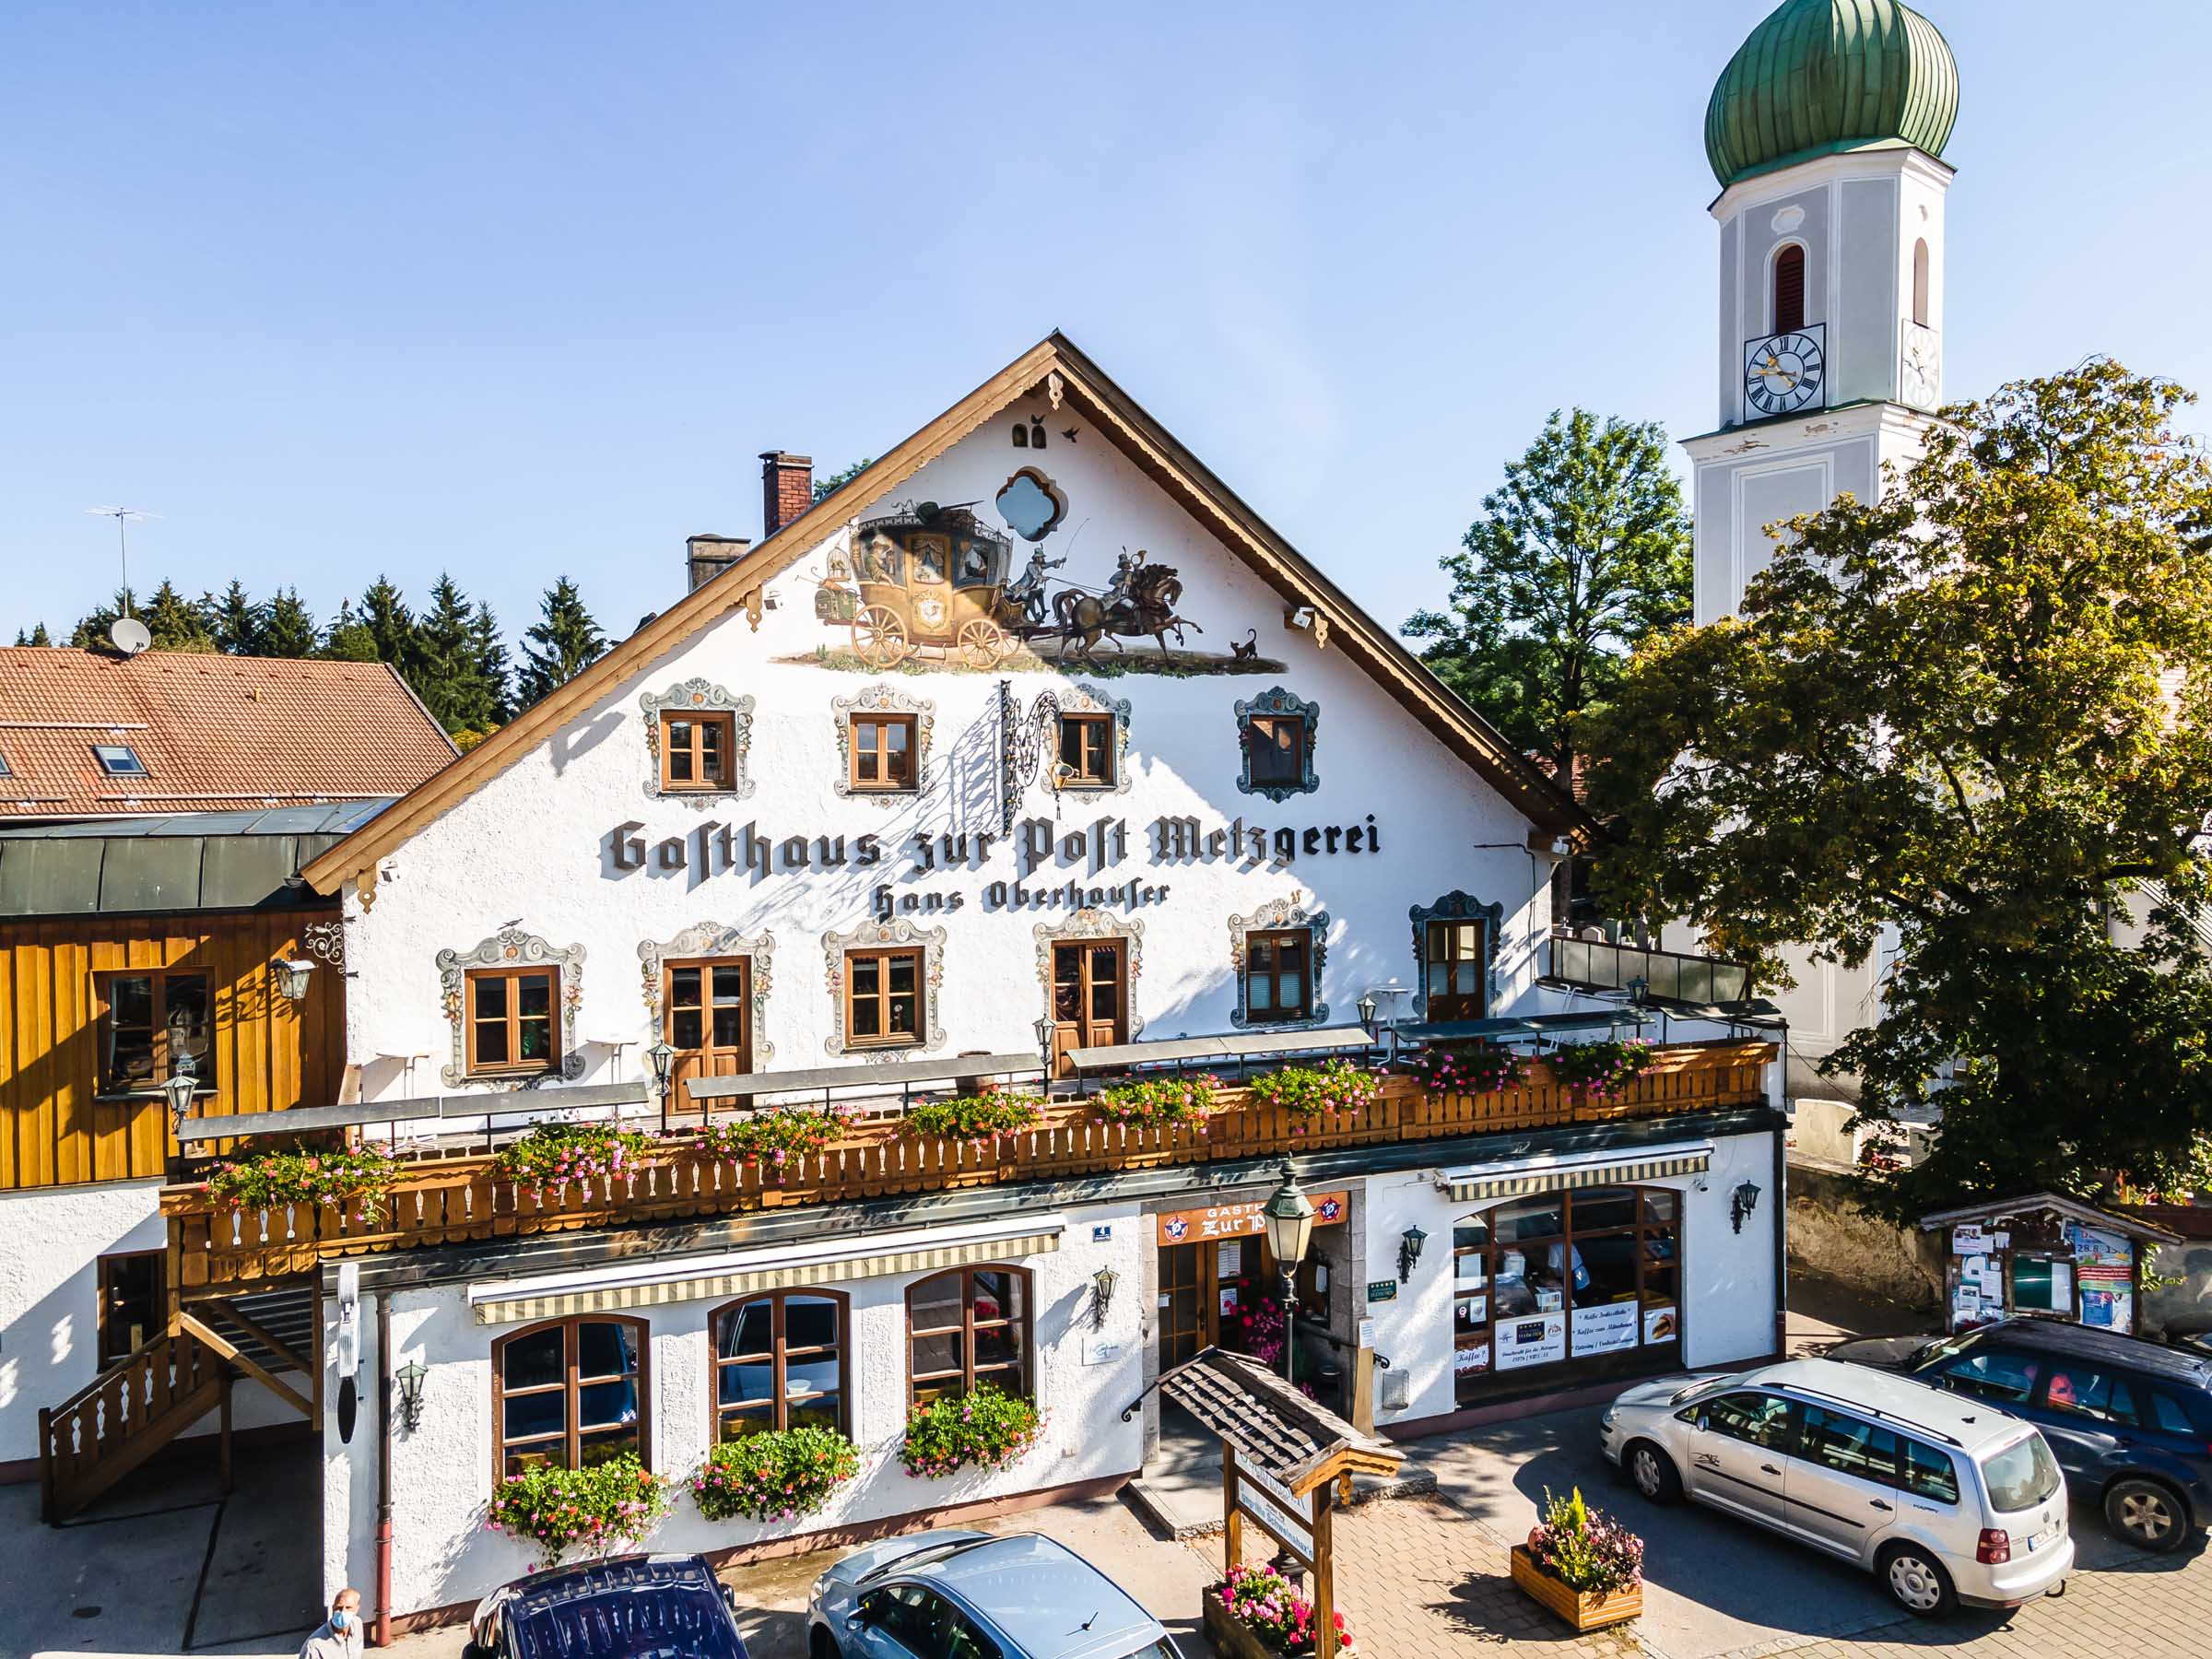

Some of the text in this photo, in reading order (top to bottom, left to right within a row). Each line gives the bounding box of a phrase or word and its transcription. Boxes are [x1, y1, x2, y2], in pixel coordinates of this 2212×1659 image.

[912, 831, 995, 875] zur
[1157, 814, 1381, 866] Metzgerei
[876, 883, 964, 924] Hans
[1207, 1202, 1266, 1218] GASTH
[1201, 1213, 1266, 1237] Zur P
[1457, 1352, 1480, 1363] Kaffee
